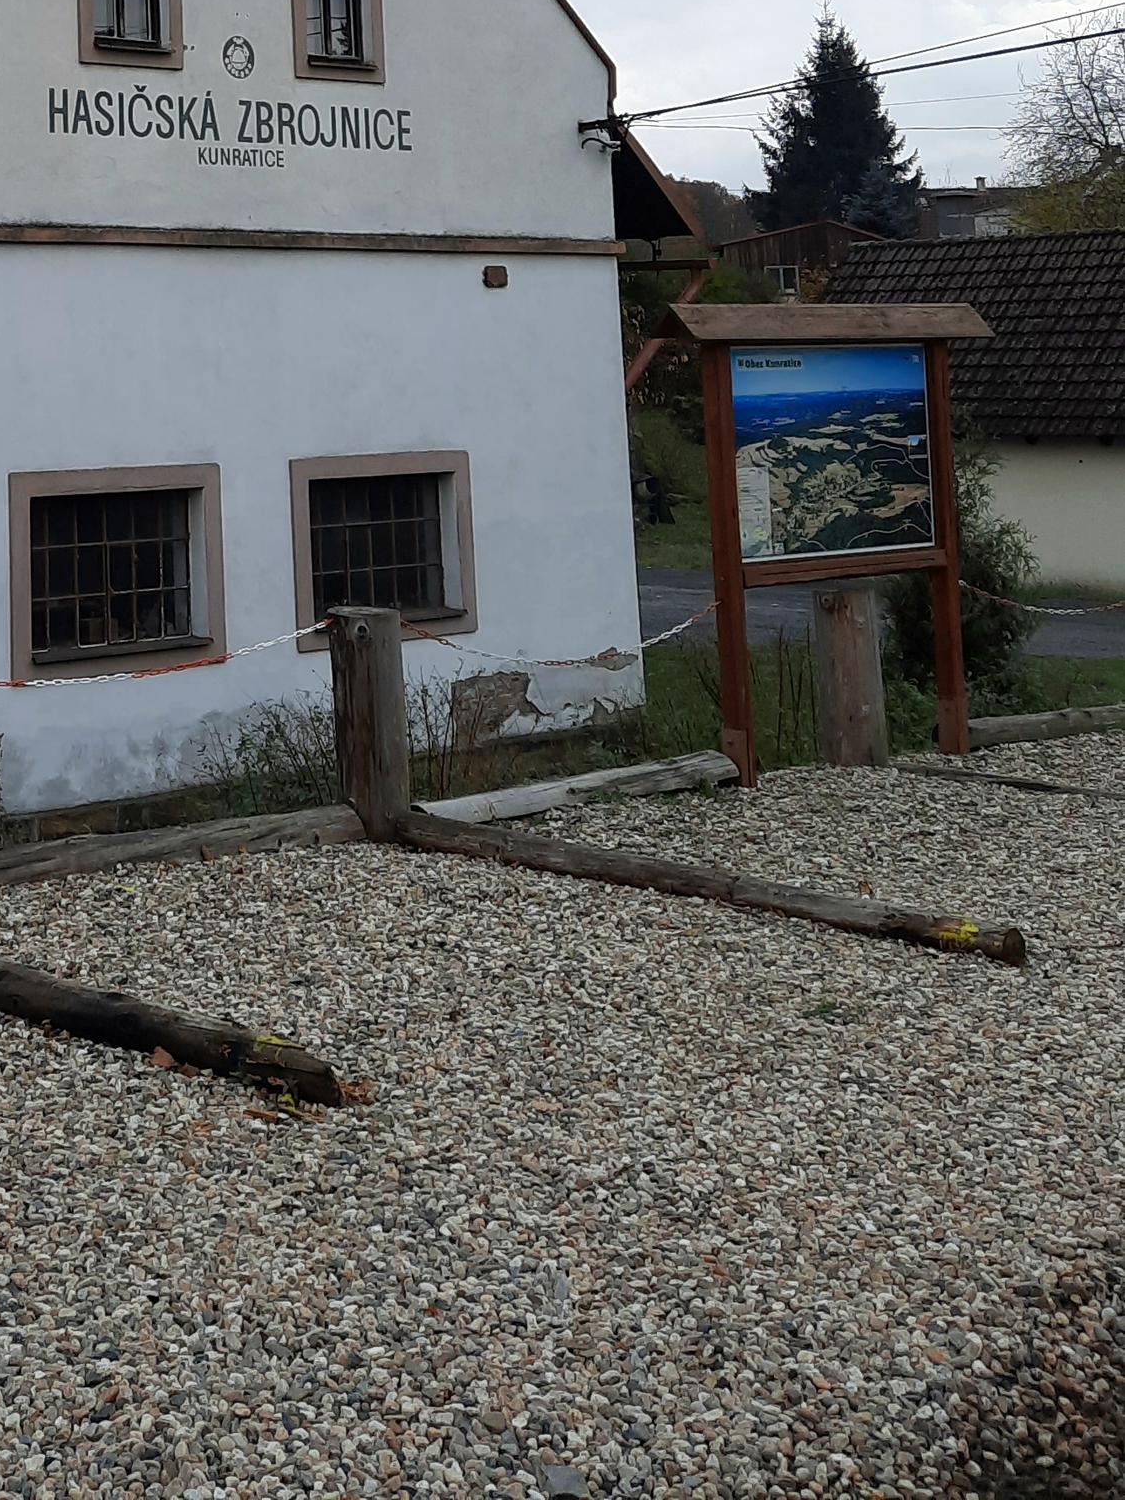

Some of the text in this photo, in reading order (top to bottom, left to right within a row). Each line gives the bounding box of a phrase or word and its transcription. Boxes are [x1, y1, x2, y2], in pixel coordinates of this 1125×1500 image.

[48, 85, 413, 152] HASIČSKÁ ZBROJNICE
[197, 146, 285, 168] KUNRATICE
